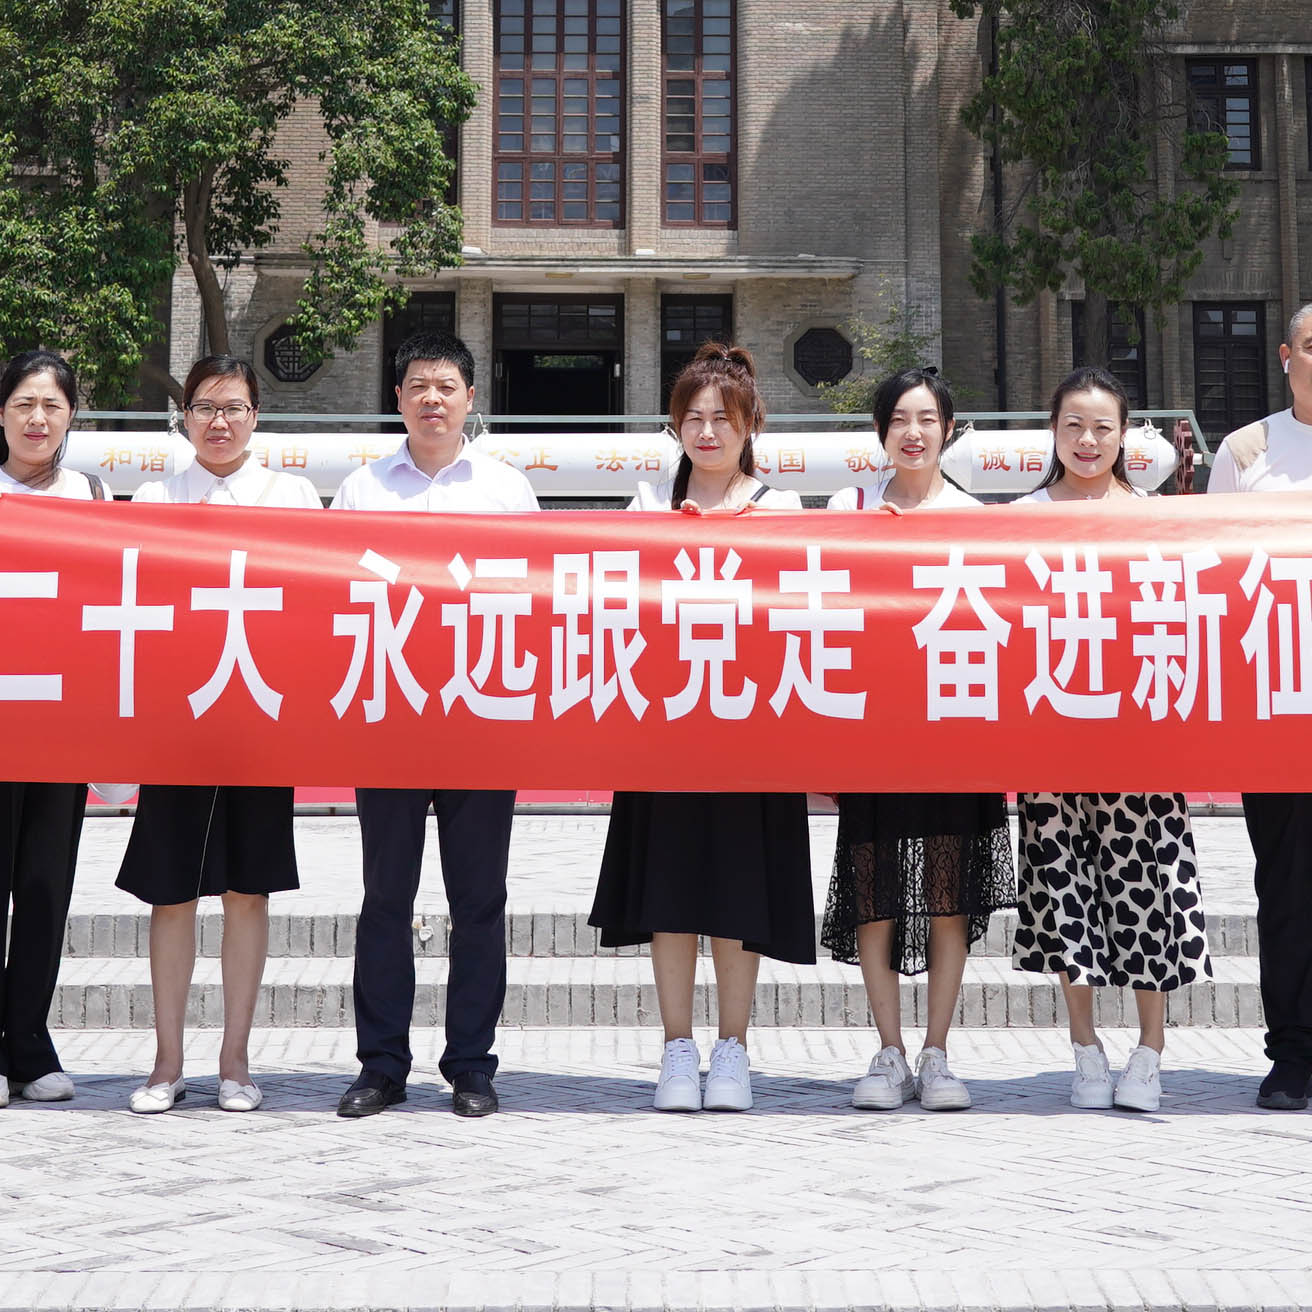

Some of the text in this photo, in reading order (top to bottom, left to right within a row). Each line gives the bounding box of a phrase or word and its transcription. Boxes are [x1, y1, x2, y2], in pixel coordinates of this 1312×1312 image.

[99, 446, 169, 473] 和谐
[594, 447, 662, 472] 法治
[978, 446, 1048, 473] 诚信
[330, 546, 868, 723] 永远跟党走
